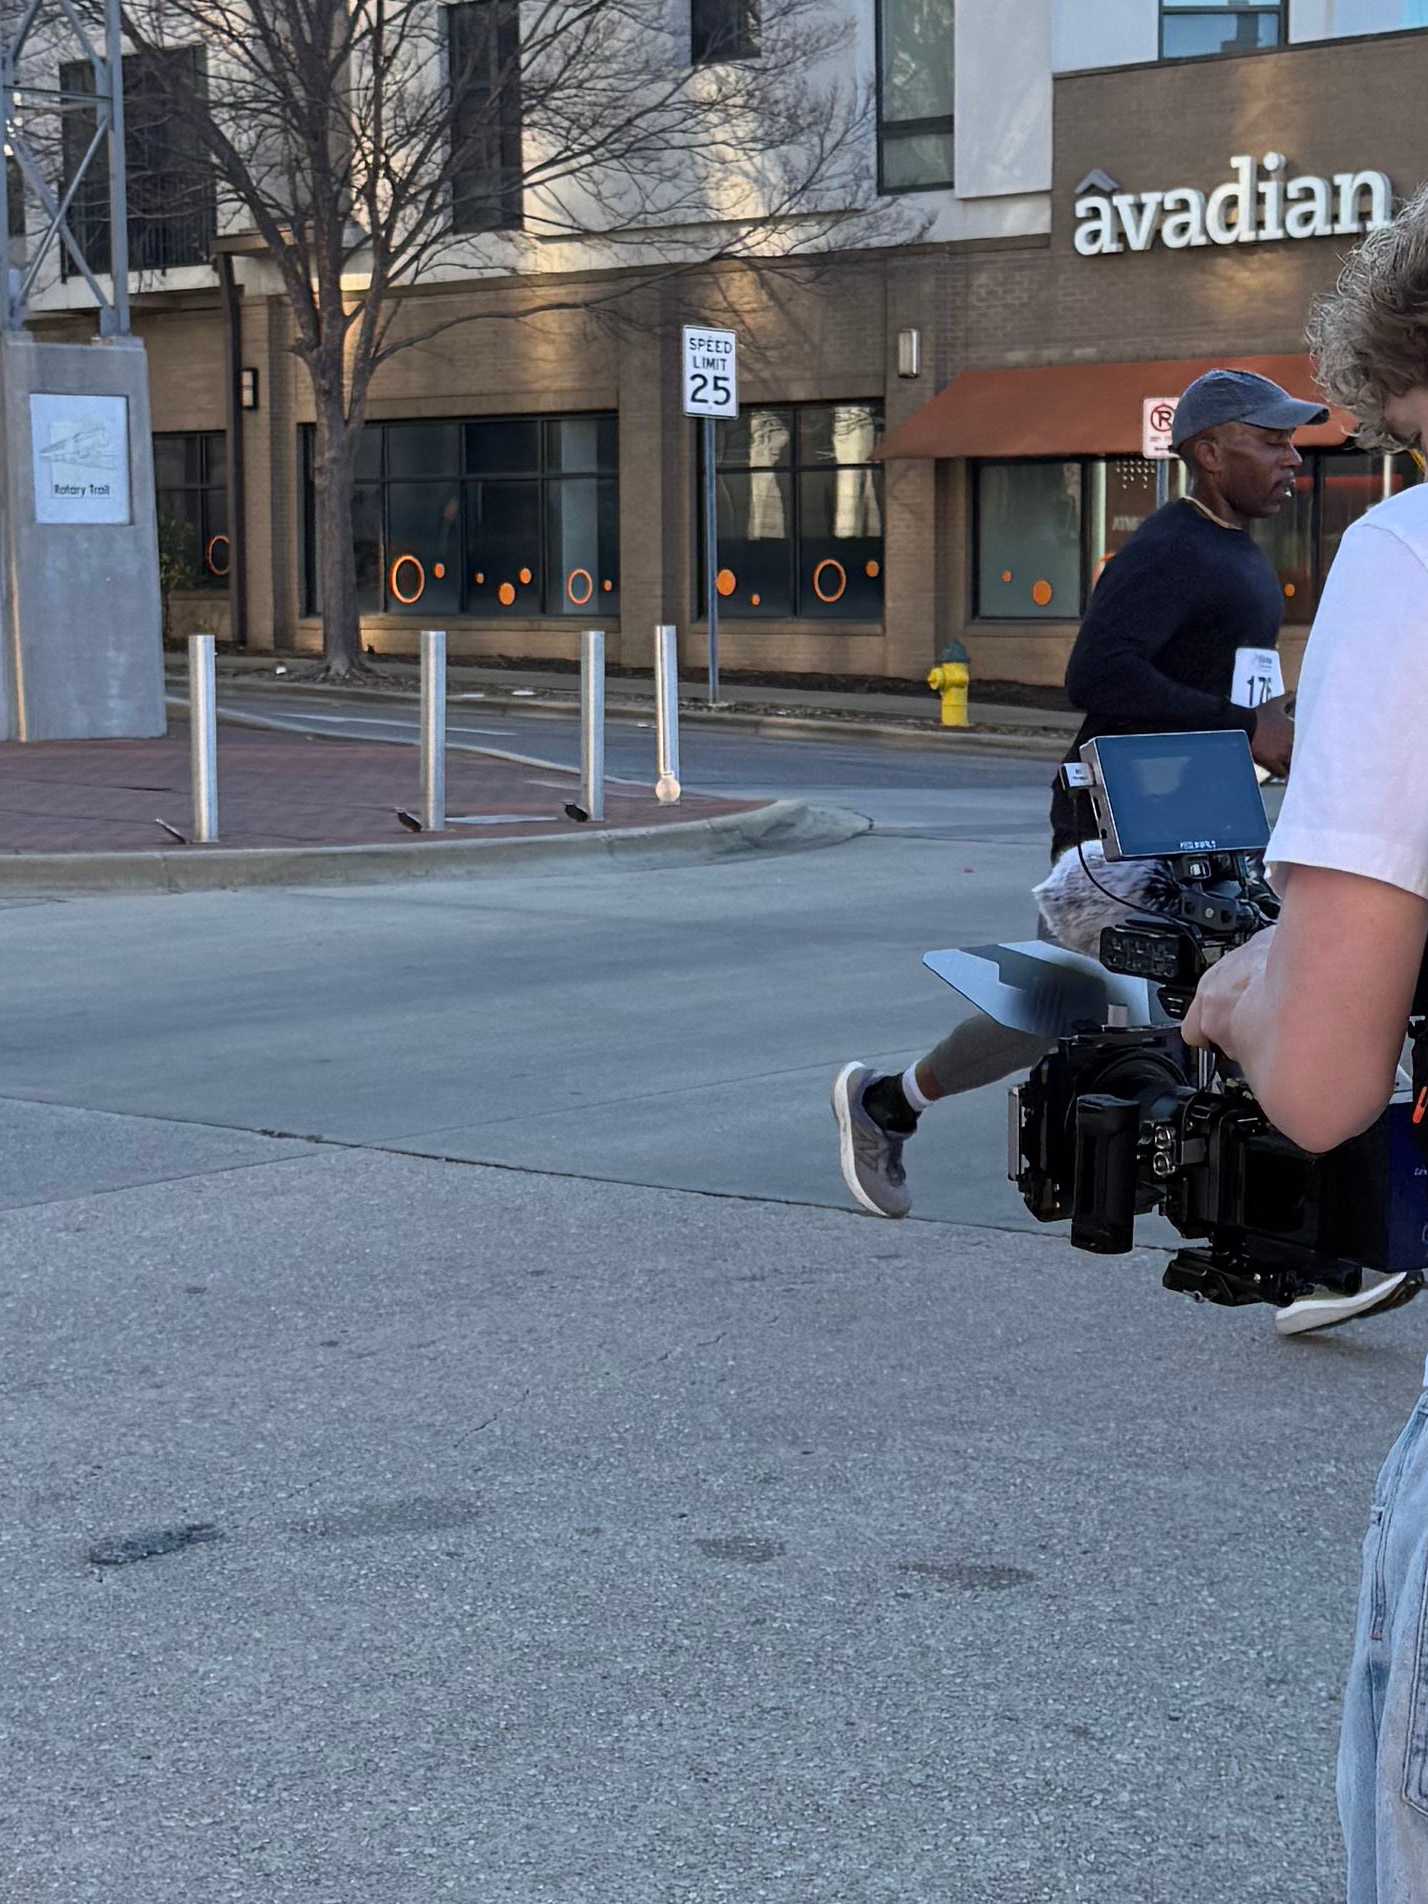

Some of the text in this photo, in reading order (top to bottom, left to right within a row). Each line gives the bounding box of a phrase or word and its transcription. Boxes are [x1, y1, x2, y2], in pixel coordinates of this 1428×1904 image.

[689, 337, 733, 355] SPEED
[692, 355, 728, 372] LIMIT
[689, 372, 732, 406] 25
